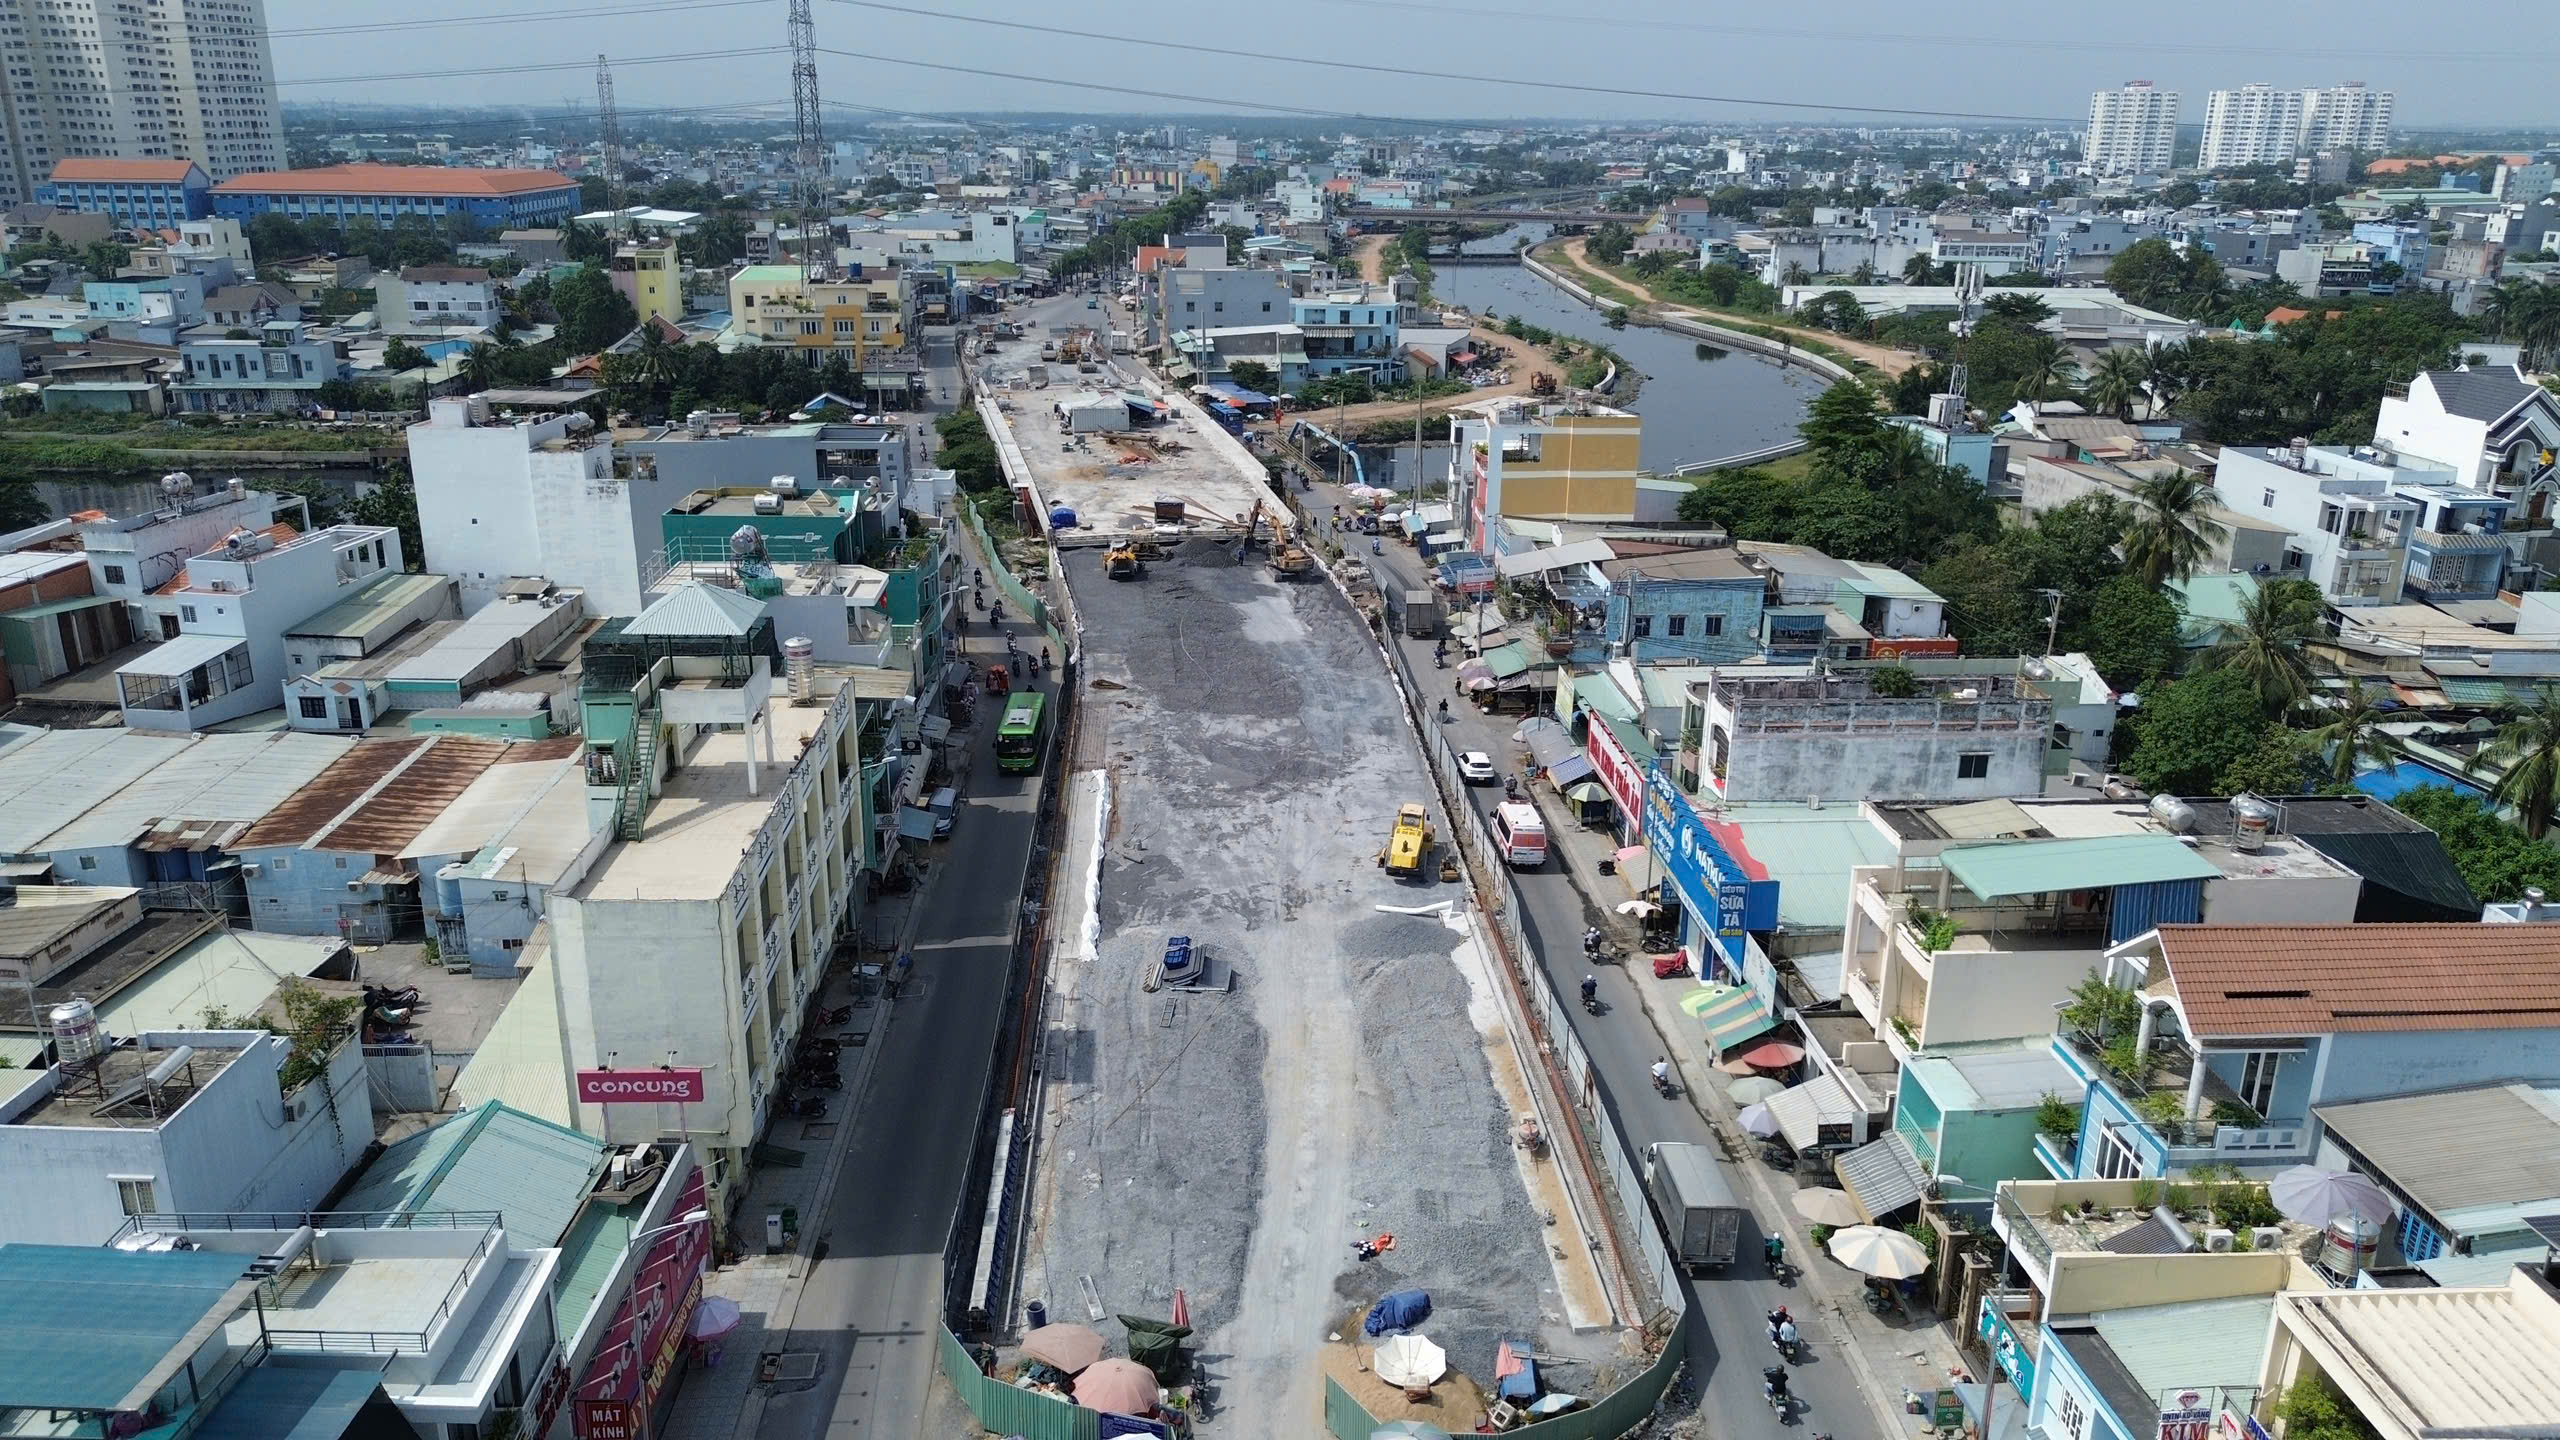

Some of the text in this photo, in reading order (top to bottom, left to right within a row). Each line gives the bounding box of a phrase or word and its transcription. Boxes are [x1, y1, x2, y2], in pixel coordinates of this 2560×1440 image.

[1719, 894, 1745, 910] SỮA
[1723, 911, 1740, 926] TÃ
[592, 1405, 621, 1422] MẮT
[593, 1423, 625, 1439] KÍNH
[2160, 1422, 2210, 1440] KIM
